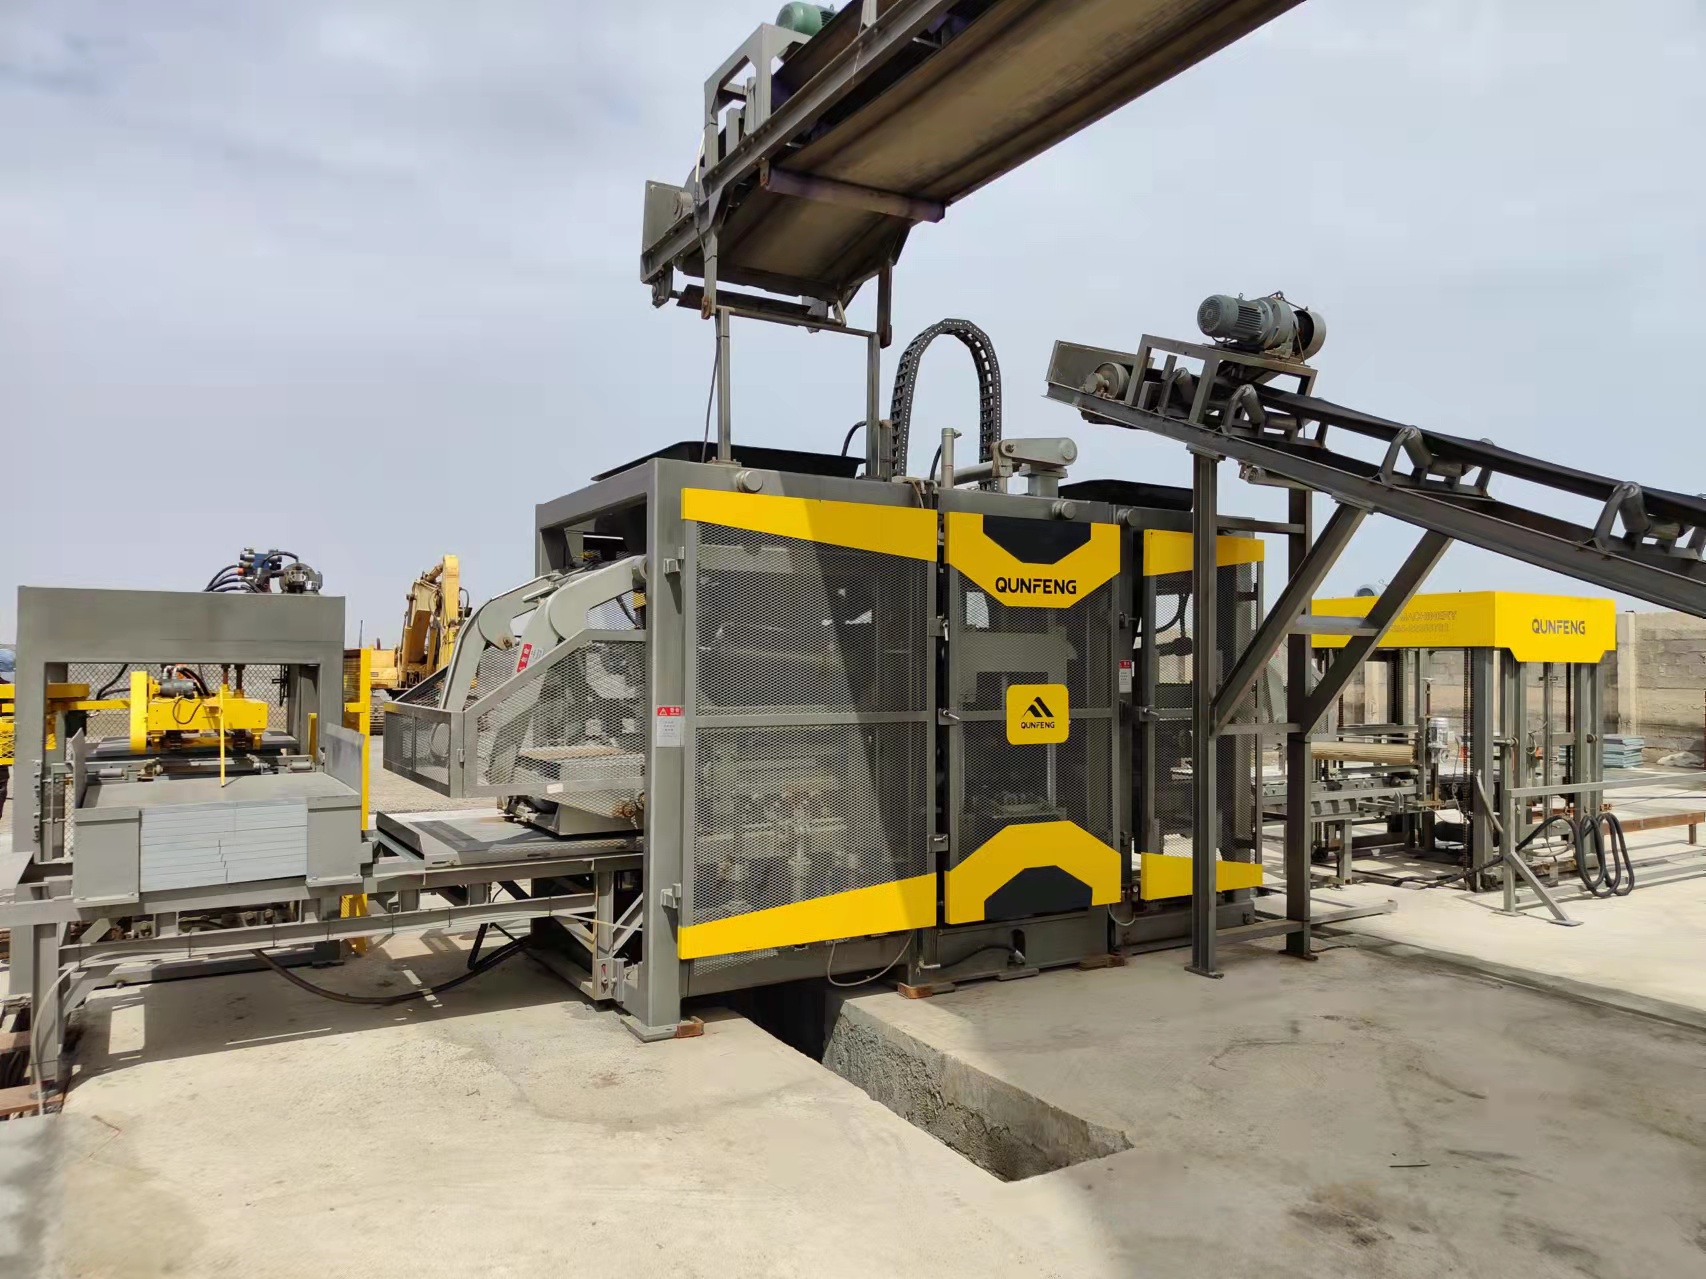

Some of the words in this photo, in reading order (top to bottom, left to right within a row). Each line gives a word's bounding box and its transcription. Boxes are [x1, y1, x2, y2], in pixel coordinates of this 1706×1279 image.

[995, 577, 1077, 595] QUNFENG
[1531, 618, 1586, 635] QUNFENG
[1020, 720, 1056, 730] QUNFENG
